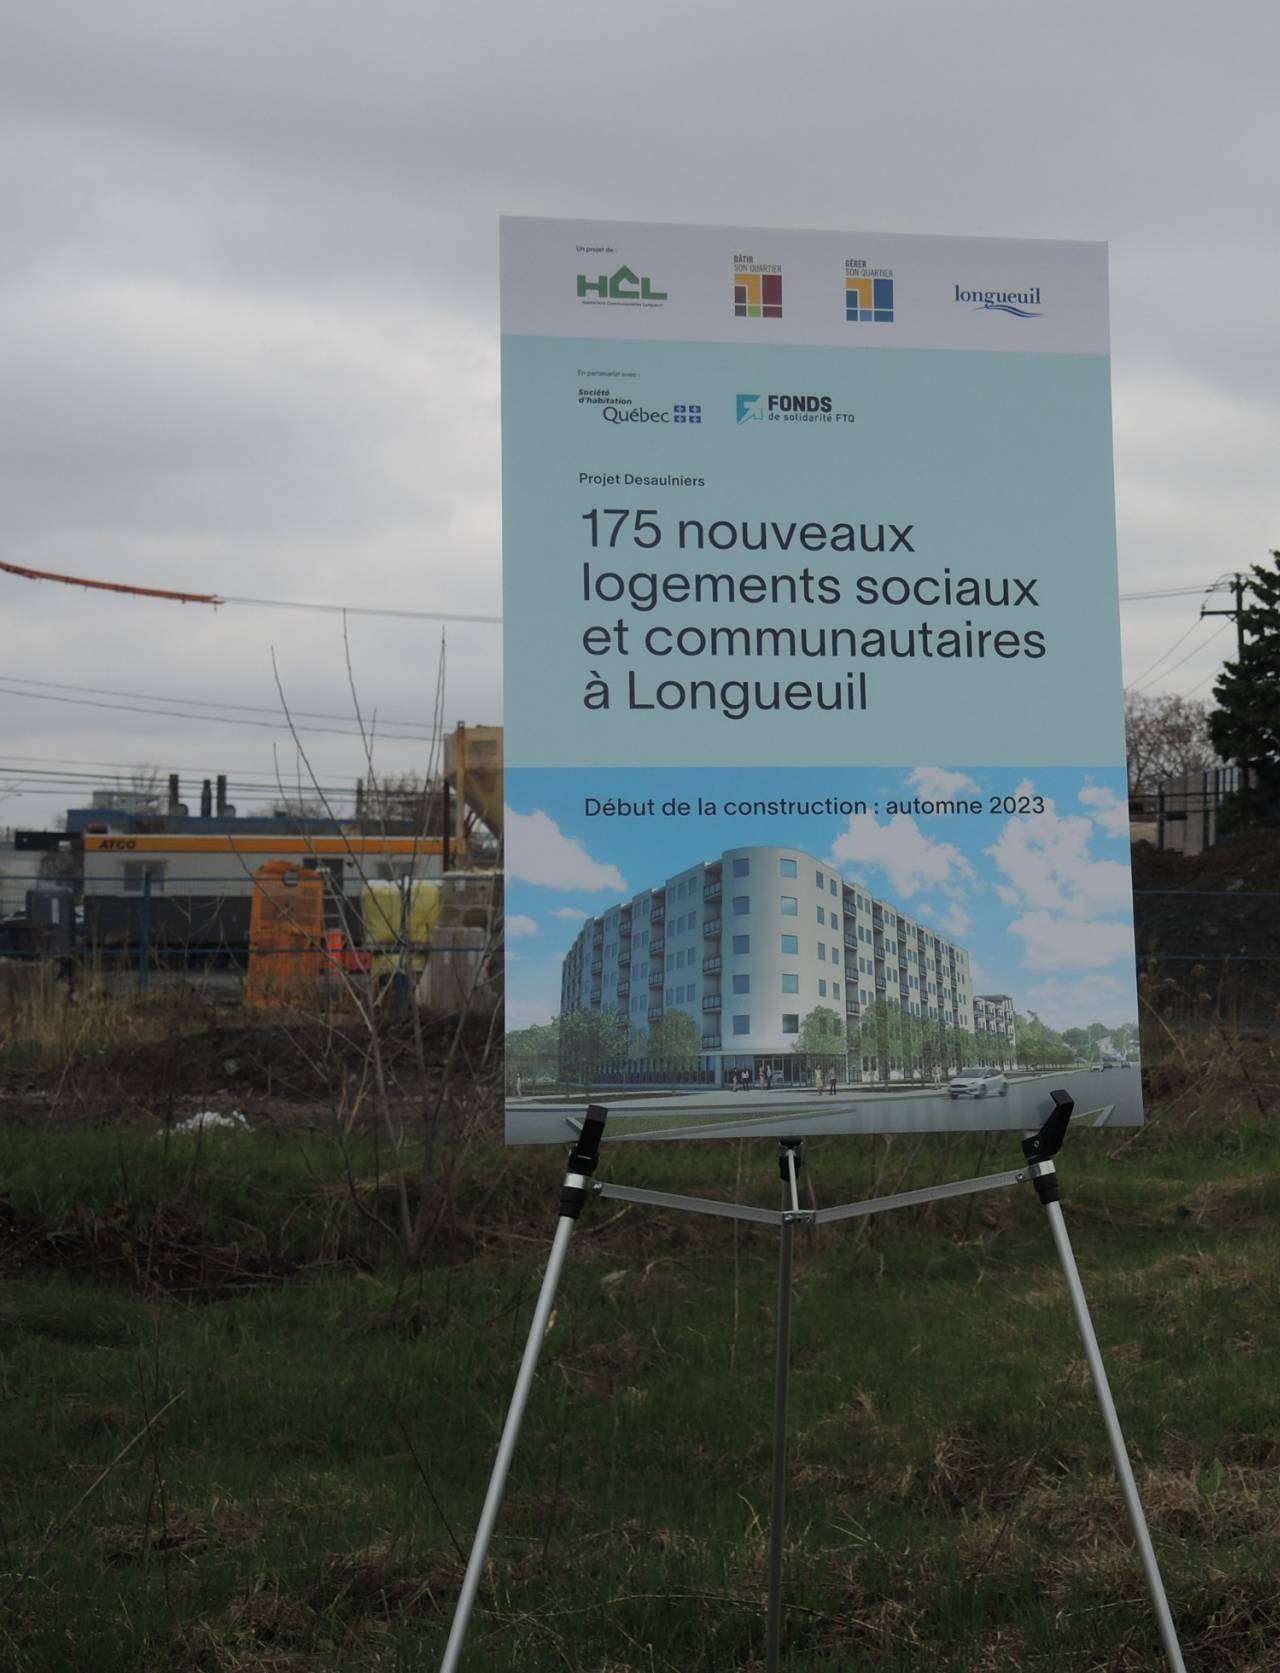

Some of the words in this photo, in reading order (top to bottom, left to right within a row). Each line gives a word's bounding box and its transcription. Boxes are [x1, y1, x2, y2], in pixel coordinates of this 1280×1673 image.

[734, 255, 754, 264] BÂTIR
[734, 264, 748, 273] SON
[750, 264, 782, 274] QUARTIER
[846, 269, 859, 278] SON
[861, 269, 893, 279] QUARTIER
[955, 284, 1041, 309] longueuil
[579, 389, 610, 397] Société
[768, 395, 832, 413] FONDS
[603, 406, 670, 425] Québec
[768, 413, 780, 421] de
[784, 413, 832, 423] solidarité
[836, 414, 855, 422] FTQ
[579, 473, 620, 487] Projet
[624, 474, 705, 487] Desaulniers
[582, 508, 662, 549] 175
[678, 519, 916, 553] nouveaux
[583, 563, 842, 612] logements
[855, 568, 1040, 606] sociaux
[582, 619, 629, 656] et
[644, 621, 1047, 659] communautaires
[583, 671, 610, 710] à
[628, 671, 867, 720] Longueuil
[585, 797, 655, 817] Début
[662, 797, 691, 817] de
[698, 797, 717, 816] la
[723, 797, 867, 816] construction
[886, 797, 982, 815] automne
[989, 796, 1045, 814] 2023
[99, 839, 136, 849] ATCO
